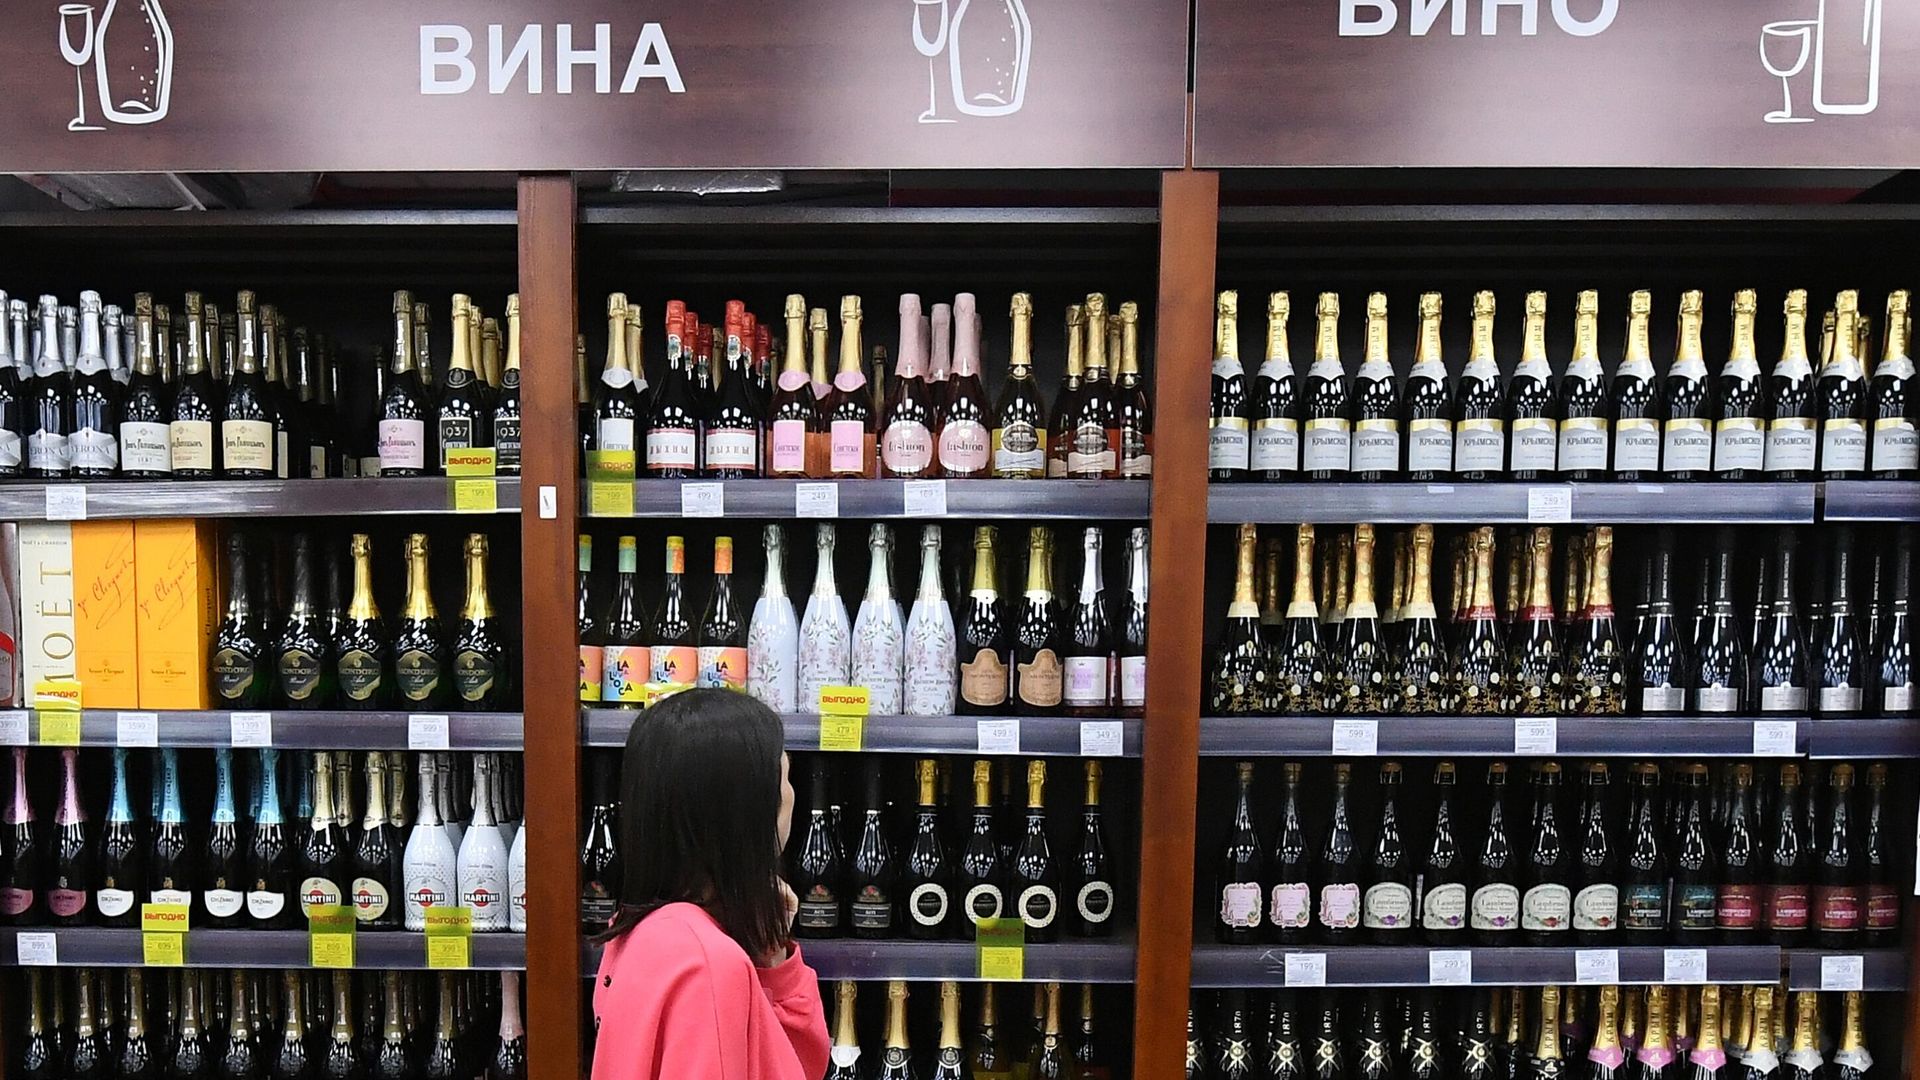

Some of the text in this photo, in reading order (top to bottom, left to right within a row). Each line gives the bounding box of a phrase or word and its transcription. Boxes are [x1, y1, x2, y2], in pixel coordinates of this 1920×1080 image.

[420, 23, 686, 94] ВИНА
[888, 440, 925, 452] fashion
[947, 440, 984, 452] fashion
[448, 457, 492, 465] ВЫГОДНО
[36, 561, 75, 683] OËT
[617, 660, 630, 672] LA
[664, 660, 676, 672] LA
[716, 662, 728, 672] LA
[822, 696, 866, 704] ВЫГОДНО
[1349, 730, 1364, 738] 599
[1530, 728, 1544, 736] 599
[302, 894, 335, 903] MARTINI
[410, 894, 444, 902] MARTINI
[464, 894, 499, 902] MARTINI
[144, 912, 186, 921] ВЫГОДНО
[428, 916, 469, 924] ВЫГОДНО
[1444, 960, 1458, 968] 299
[1590, 959, 1605, 968] 299
[1680, 959, 1694, 968] 299
[1234, 1010, 1242, 1034] 1870
[1282, 1012, 1290, 1035] 1870
[1323, 1010, 1332, 1034] 1870
[1422, 1012, 1431, 1034] 1870
[1476, 1012, 1484, 1034] 1870
[1606, 1012, 1614, 1043] КРЫМ
[1650, 1012, 1660, 1044] КРЫМ
[1544, 1018, 1554, 1049] КРЫМ
[1706, 1014, 1715, 1044] КРЫМ
[1760, 1017, 1769, 1048] КРЫМ
[1803, 1016, 1812, 1047] КРЫМ
